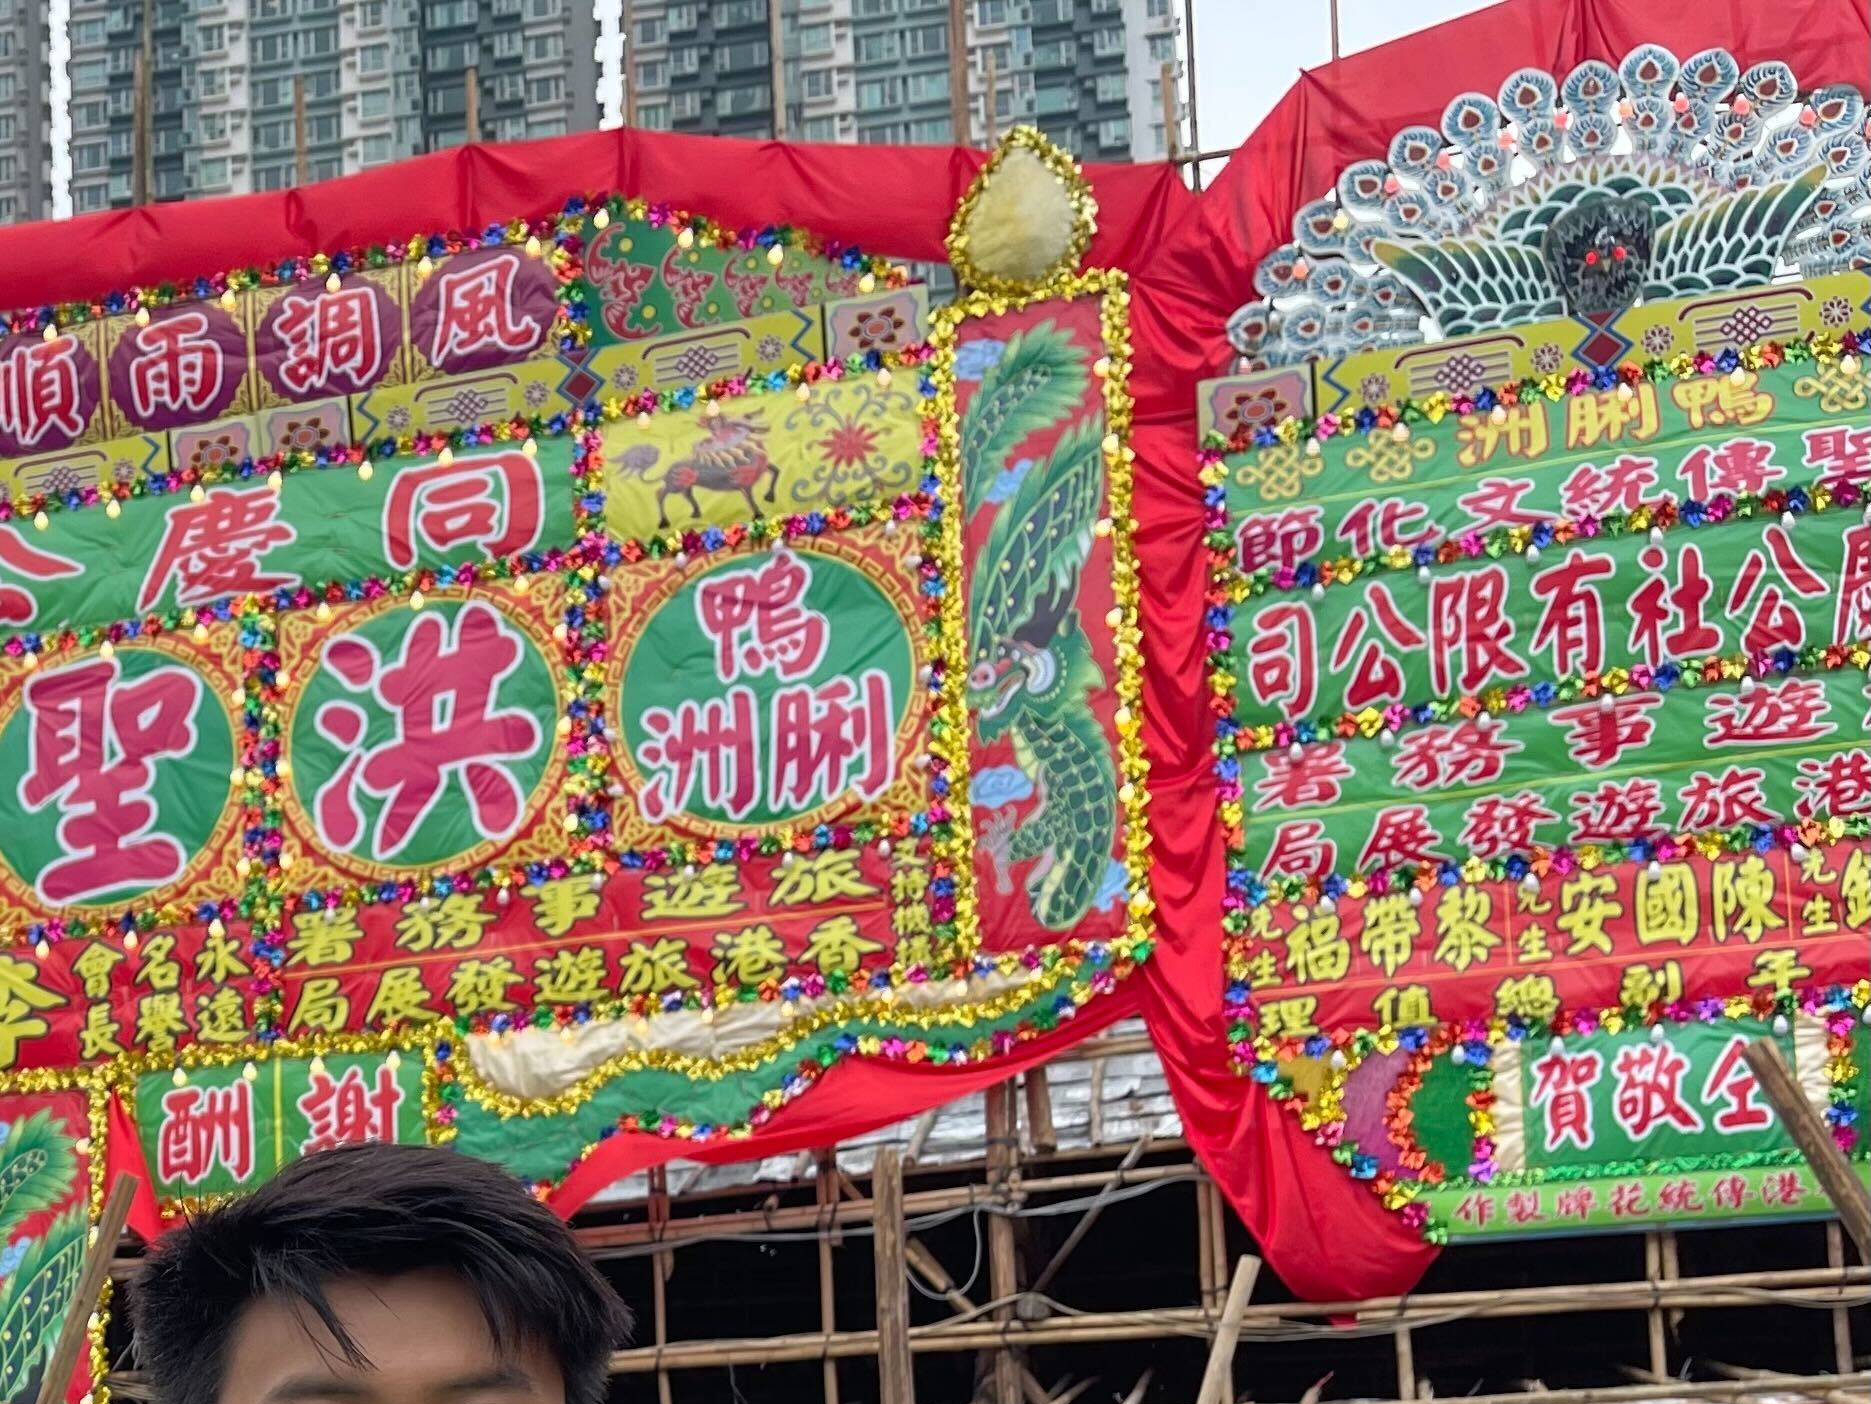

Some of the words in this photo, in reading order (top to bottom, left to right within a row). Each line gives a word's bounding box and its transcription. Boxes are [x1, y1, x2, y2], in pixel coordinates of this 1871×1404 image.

[1253, 676, 1871, 812] 遊事務署
[287, 847, 880, 968] 旅遊事務署
[289, 915, 885, 1034] 香港旅遊發展局
[1456, 1169, 1831, 1229] 港傳統花牌製作
